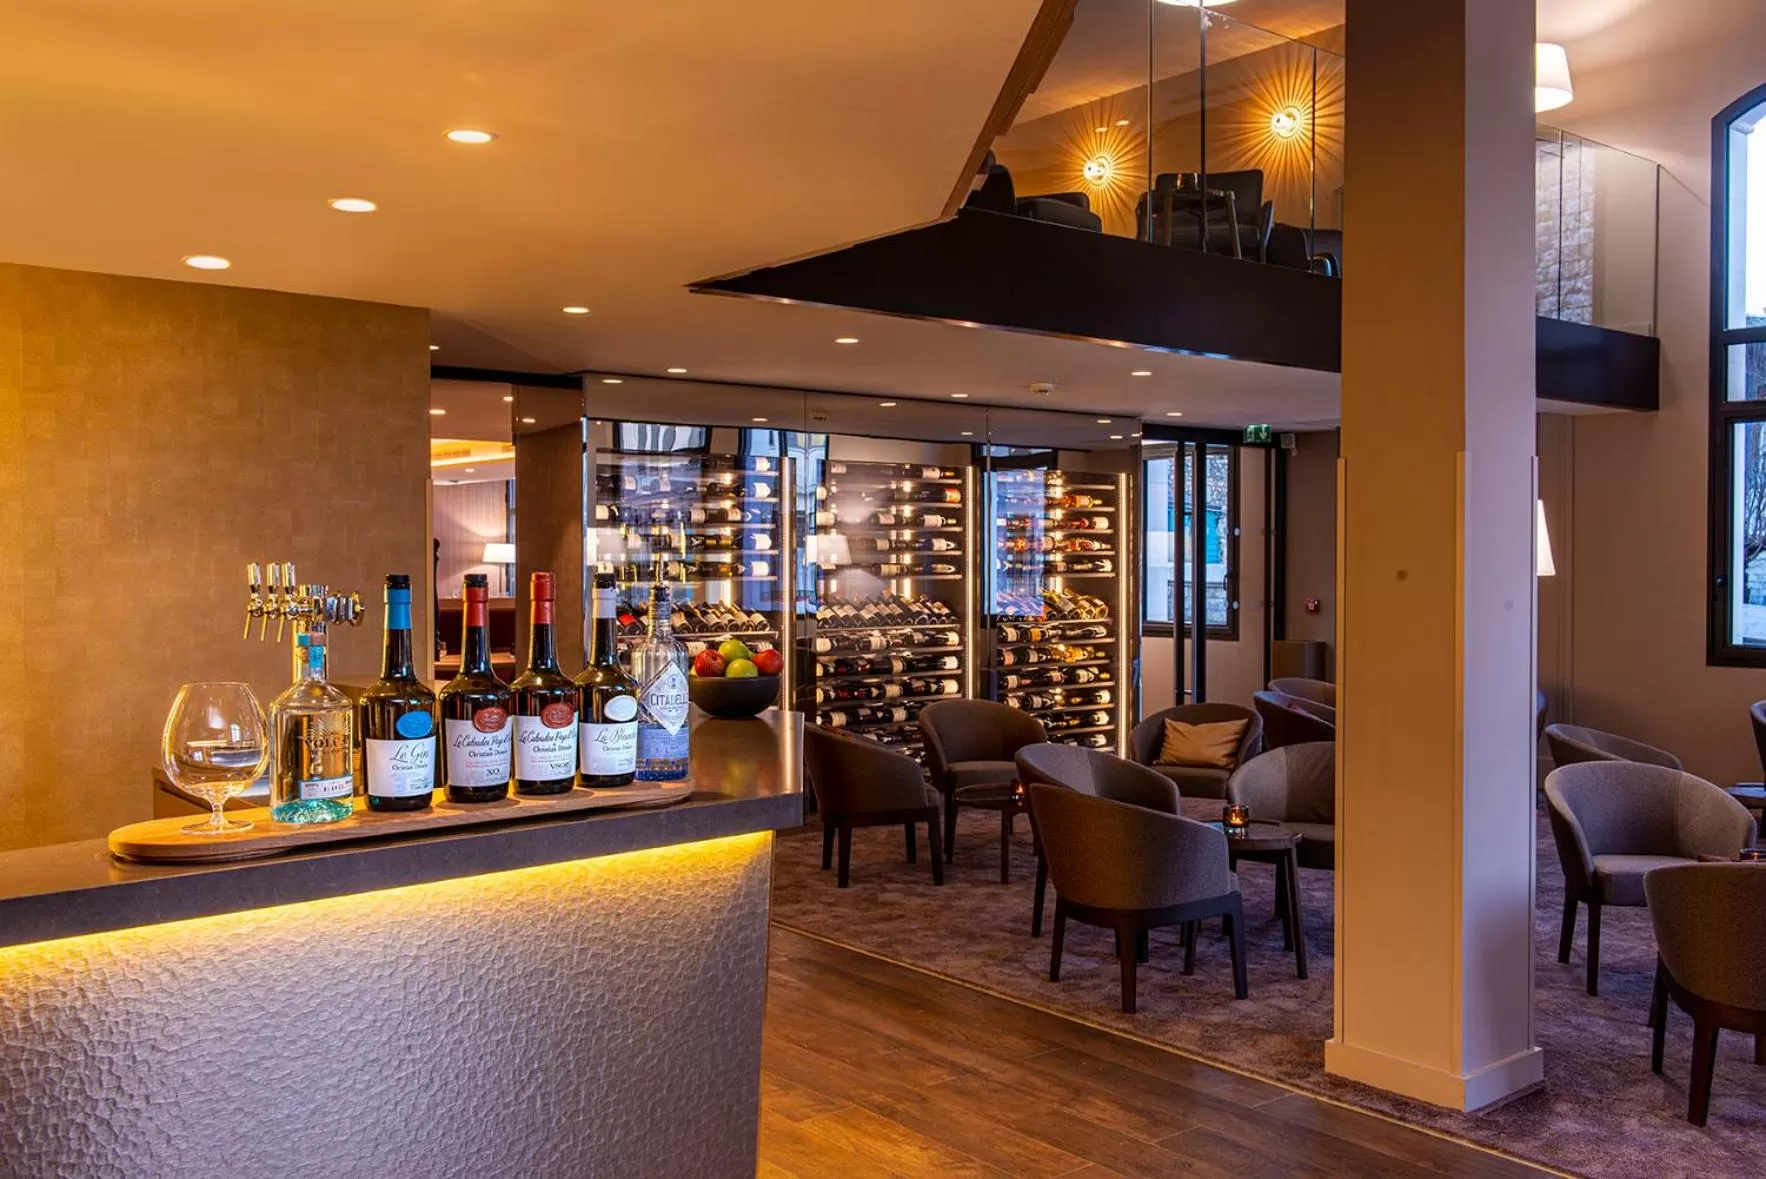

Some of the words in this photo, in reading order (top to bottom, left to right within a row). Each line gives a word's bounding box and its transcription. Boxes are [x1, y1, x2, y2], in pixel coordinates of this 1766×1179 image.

[651, 693, 689, 706] CITADELL
[453, 734, 464, 749] Le
[519, 730, 529, 744] Le
[389, 743, 409, 763] Le
[410, 742, 429, 764] Gin
[467, 750, 493, 758] Christian
[486, 768, 500, 777] XO
